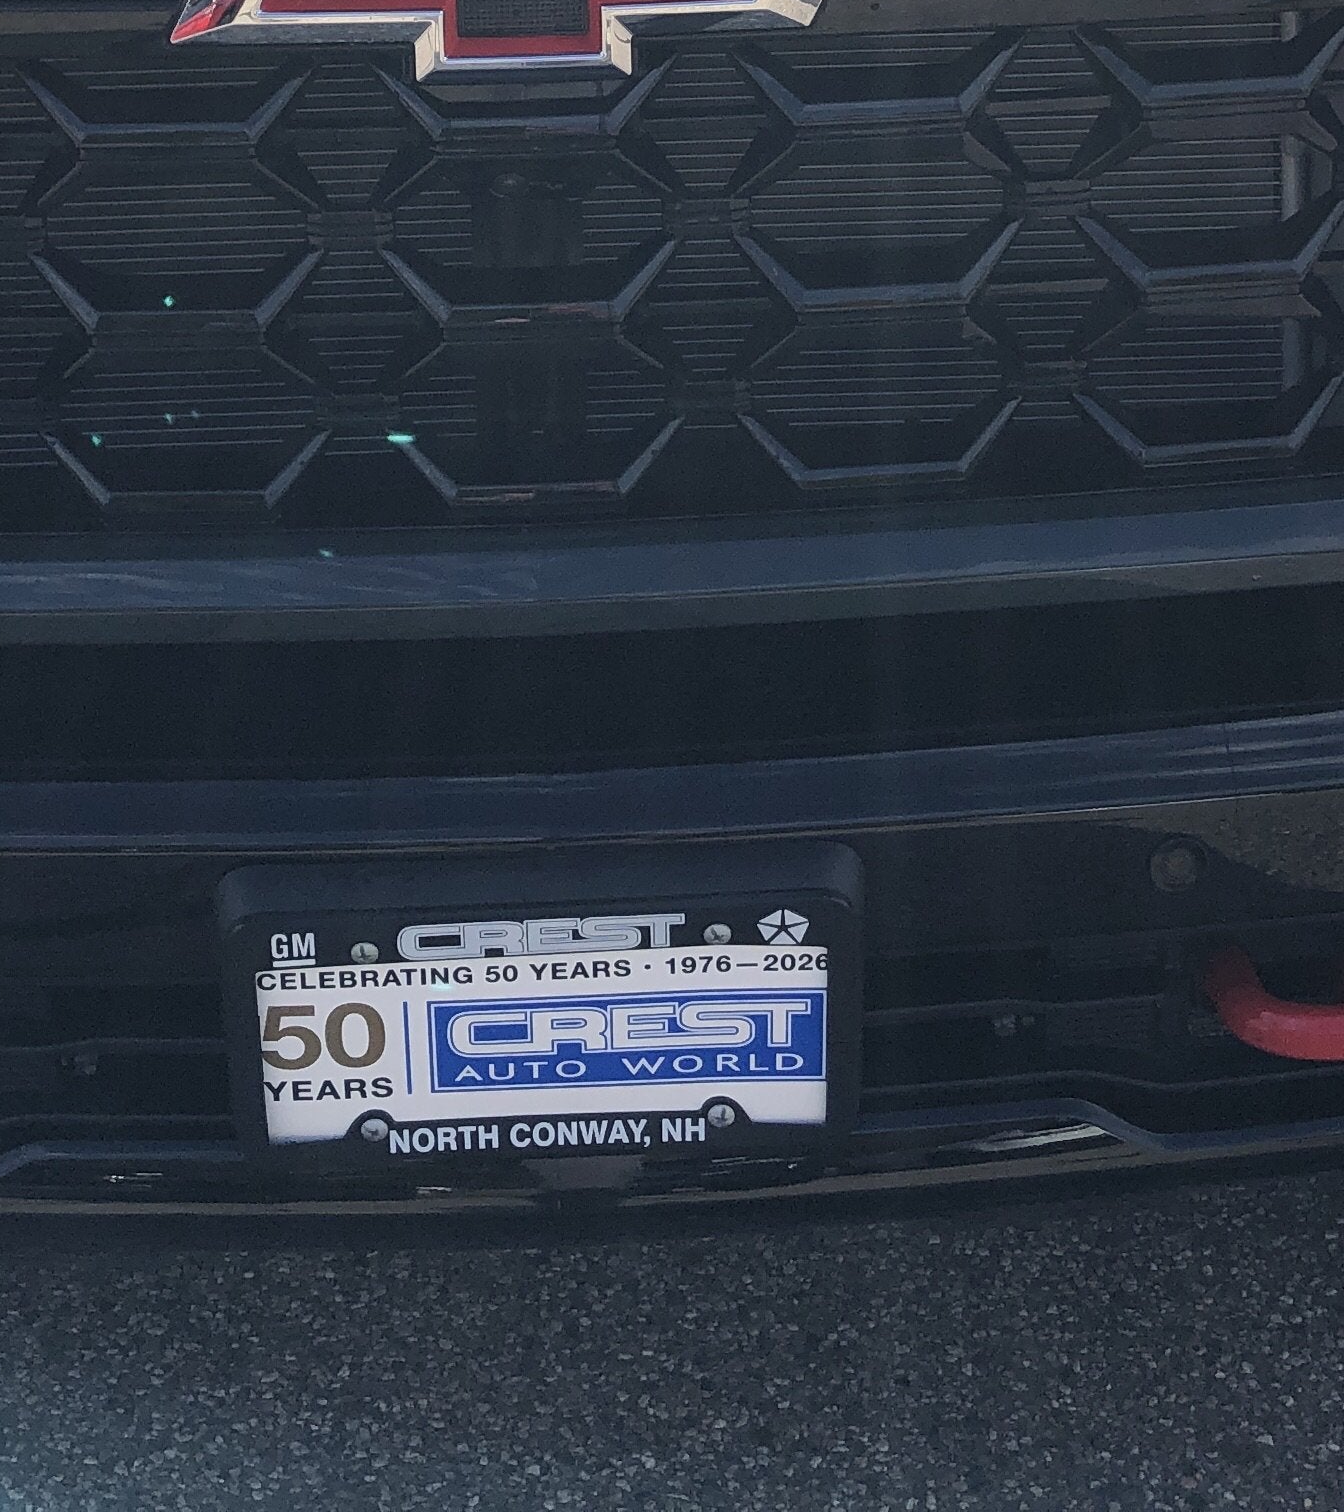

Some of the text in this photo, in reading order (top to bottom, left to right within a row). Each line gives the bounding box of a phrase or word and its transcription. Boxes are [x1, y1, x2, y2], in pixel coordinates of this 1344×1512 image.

[270, 932, 317, 960] GM
[396, 913, 686, 961] CREST
[256, 967, 474, 991] CELEBRATING
[485, 964, 519, 984] 50
[529, 959, 632, 981] YEARS
[261, 1002, 386, 1070] 50
[447, 999, 811, 1058] CREST
[454, 1053, 804, 1082] AUTO WORLD
[263, 1076, 394, 1102] YEARS
[389, 1117, 706, 1154] NORTH CONWAY, NH
